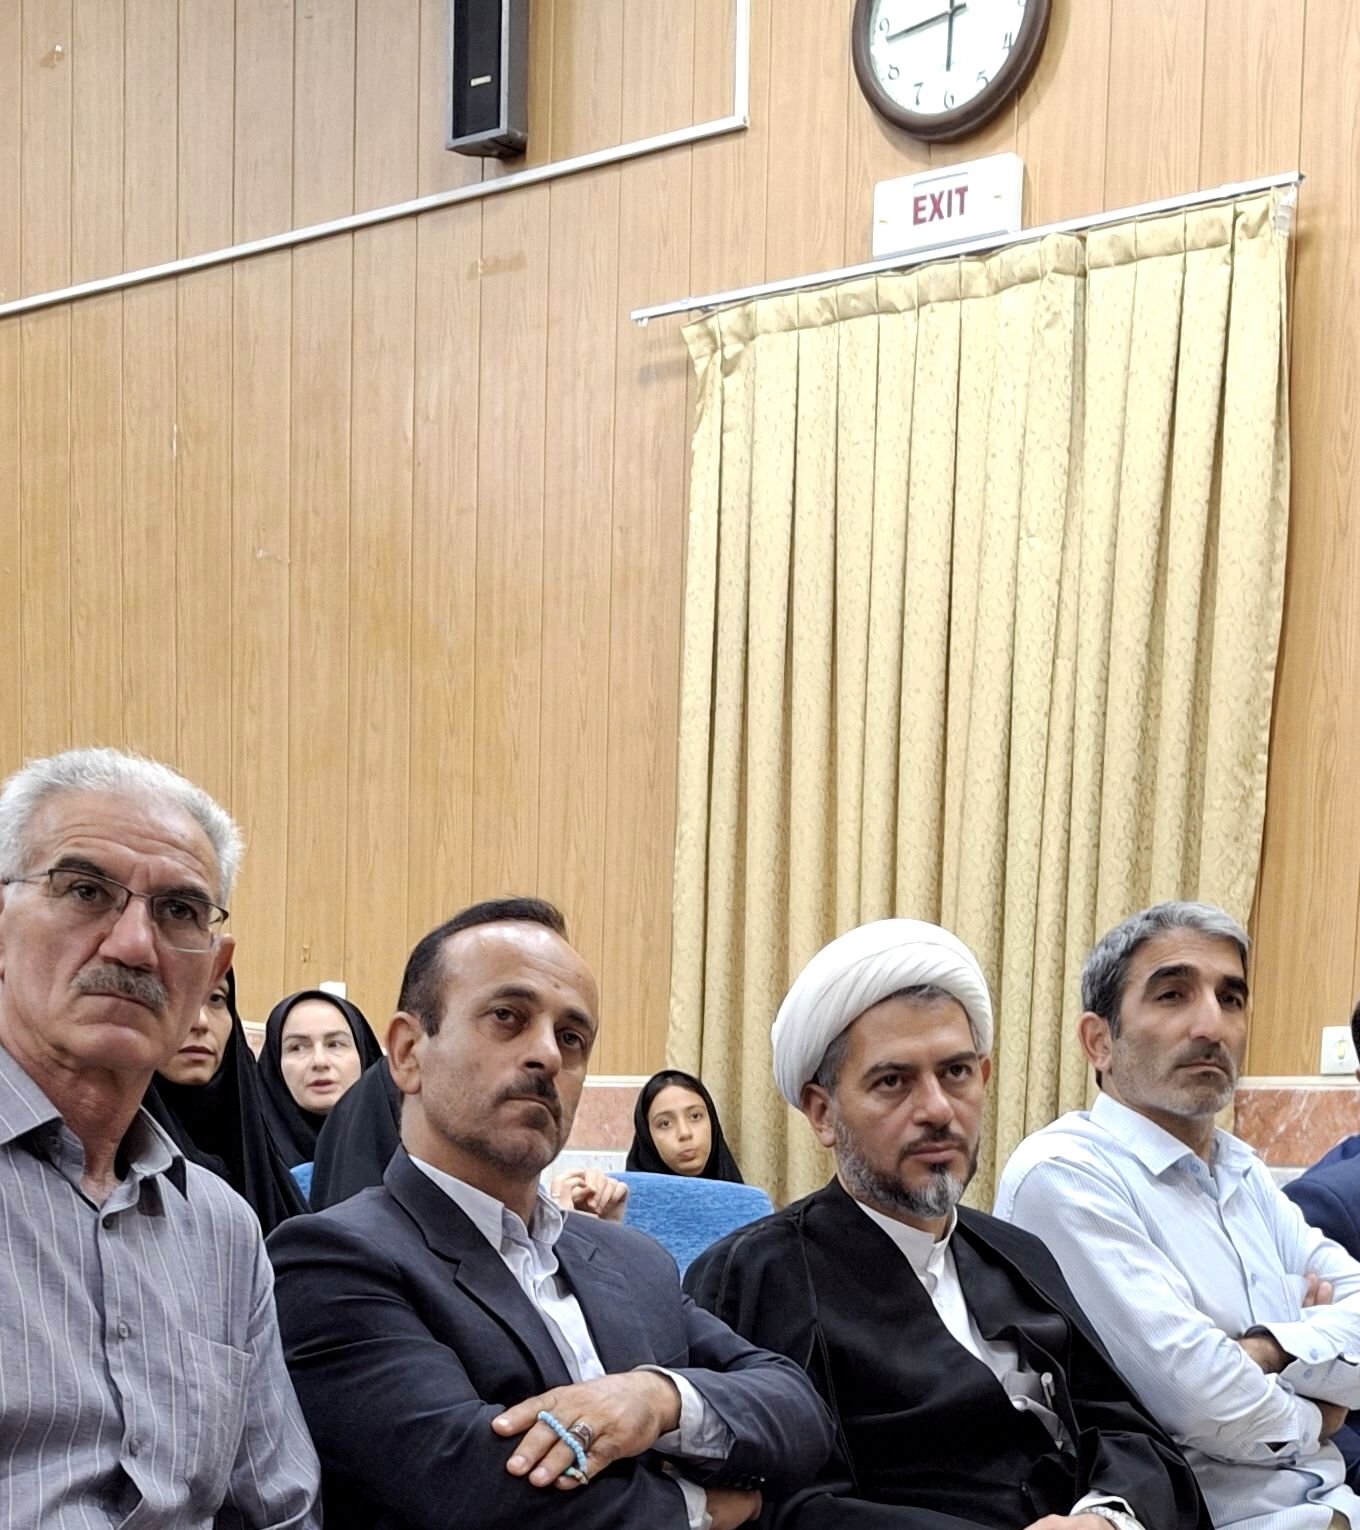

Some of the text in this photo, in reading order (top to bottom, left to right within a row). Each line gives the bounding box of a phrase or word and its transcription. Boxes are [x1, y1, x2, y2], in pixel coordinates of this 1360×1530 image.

[1002, 32, 1014, 51] 4
[976, 69, 989, 89] 5
[913, 82, 924, 106] 7
[943, 87, 955, 110] 6
[912, 185, 968, 226] EXIT
